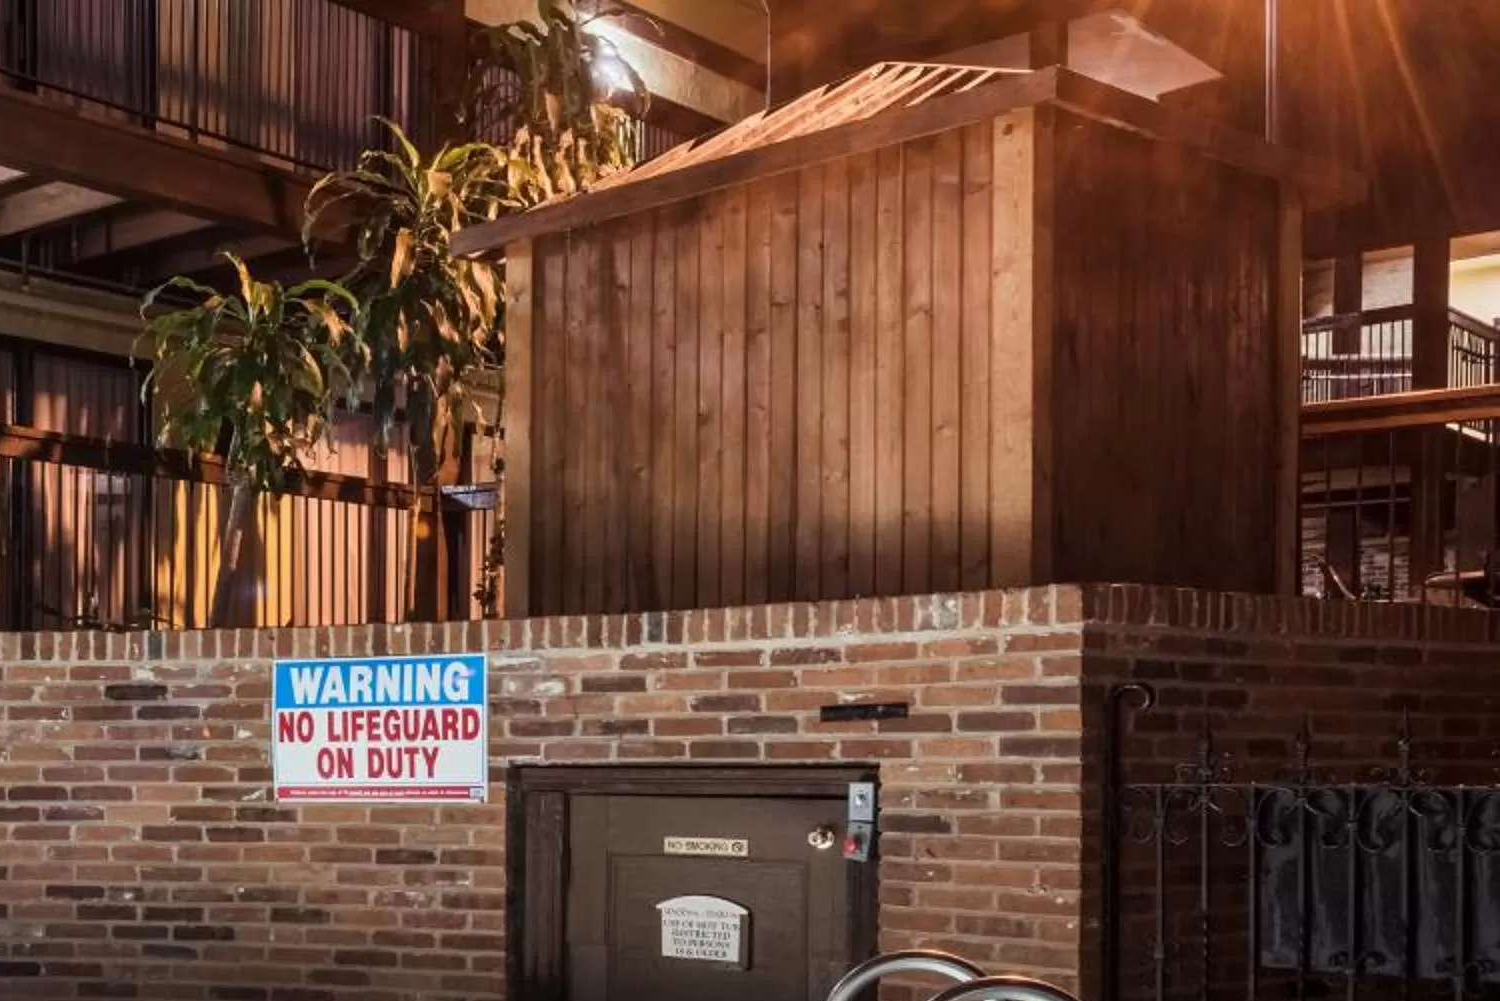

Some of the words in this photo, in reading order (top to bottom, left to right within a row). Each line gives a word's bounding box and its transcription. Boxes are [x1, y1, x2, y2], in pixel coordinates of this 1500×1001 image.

[289, 661, 471, 705] WARNING
[278, 711, 315, 743] NO
[327, 708, 481, 742] LIFEGUARD
[316, 747, 354, 780] ON
[367, 746, 440, 779] DUTY
